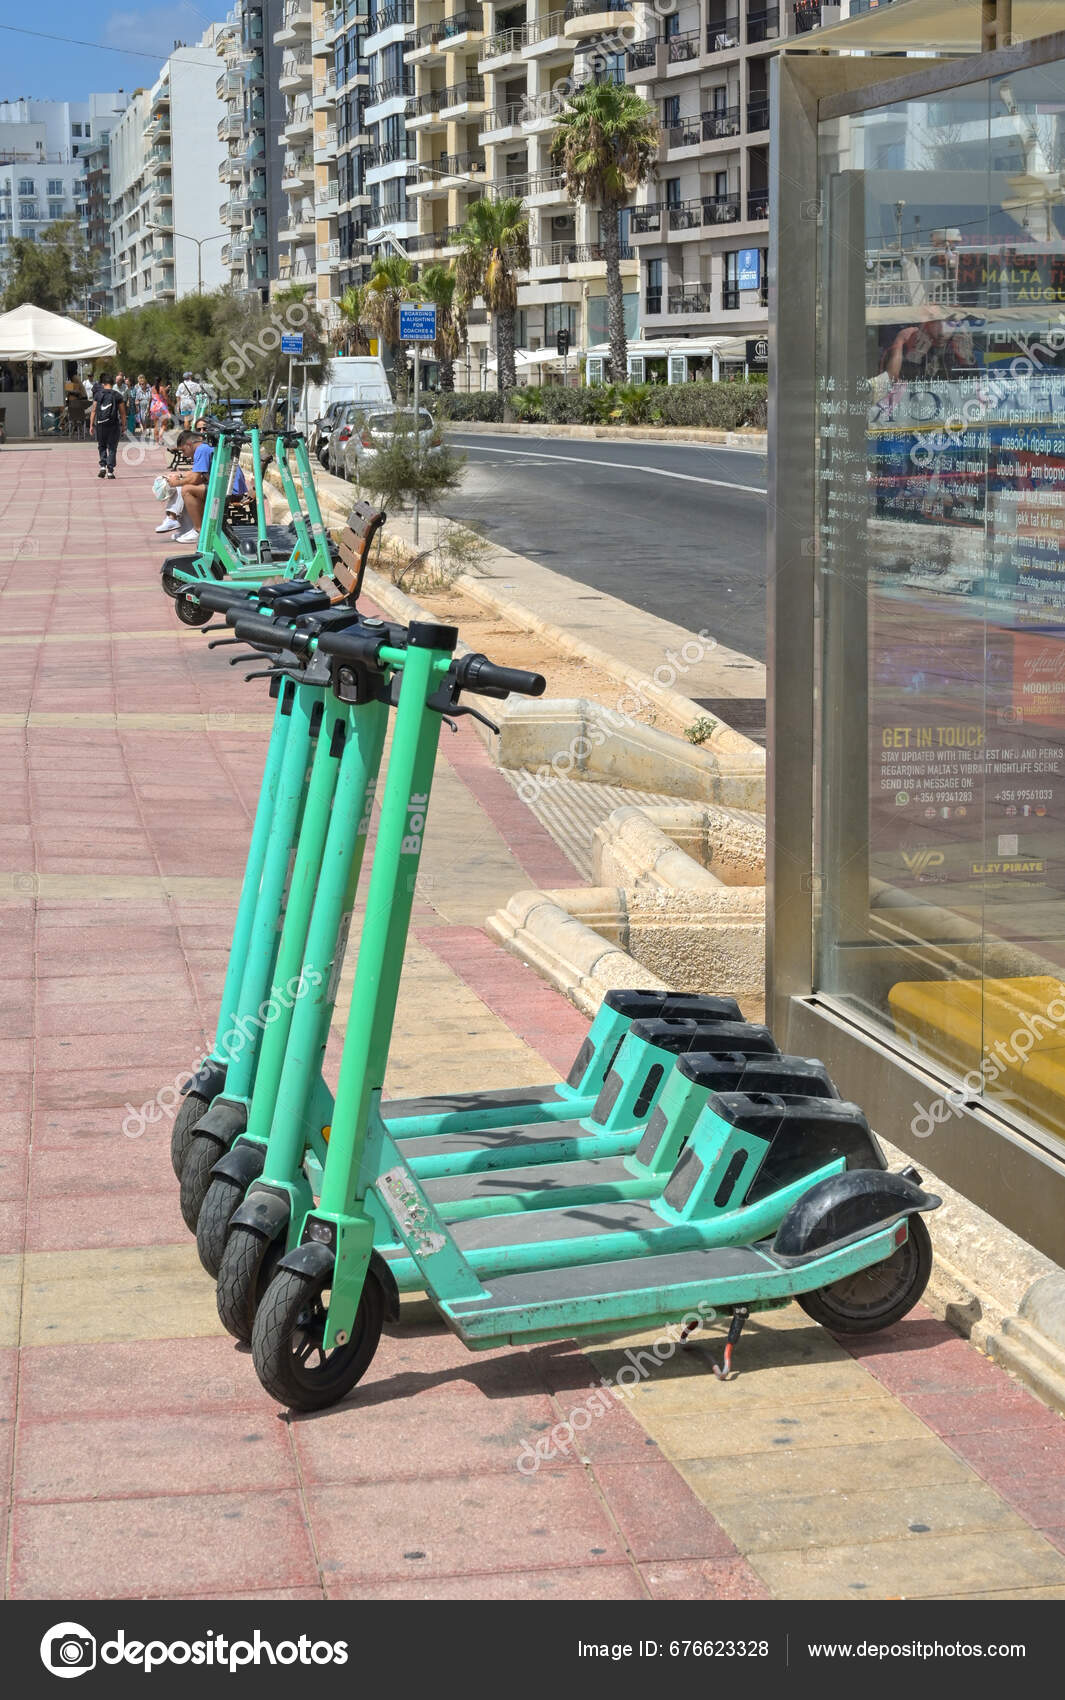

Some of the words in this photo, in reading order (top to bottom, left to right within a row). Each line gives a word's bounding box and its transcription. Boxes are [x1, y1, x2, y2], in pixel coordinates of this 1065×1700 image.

[981, 268, 1042, 283] MALTA
[881, 727, 912, 748] GET
[916, 727, 932, 748] IN
[881, 751, 899, 762] STAY
[901, 750, 935, 762] UPDATED
[936, 750, 956, 761] WITH
[958, 750, 972, 761] THE
[973, 749, 1000, 761] LAEST
[1021, 748, 1037, 759] AND
[1039, 747, 1064, 759] PERKS
[881, 764, 926, 777] REGARDING
[927, 763, 959, 776] MALTA'S
[960, 762, 993, 775] VIBRAT
[993, 762, 1032, 774] NIGHTLIFE
[880, 778, 902, 790] SEND
[903, 778, 915, 790] US
[923, 777, 959, 789] MESSAGE
[994, 790, 1015, 801] +356
[400, 792, 428, 855] Bolt
[1002, 862, 1044, 873] PIRATE
